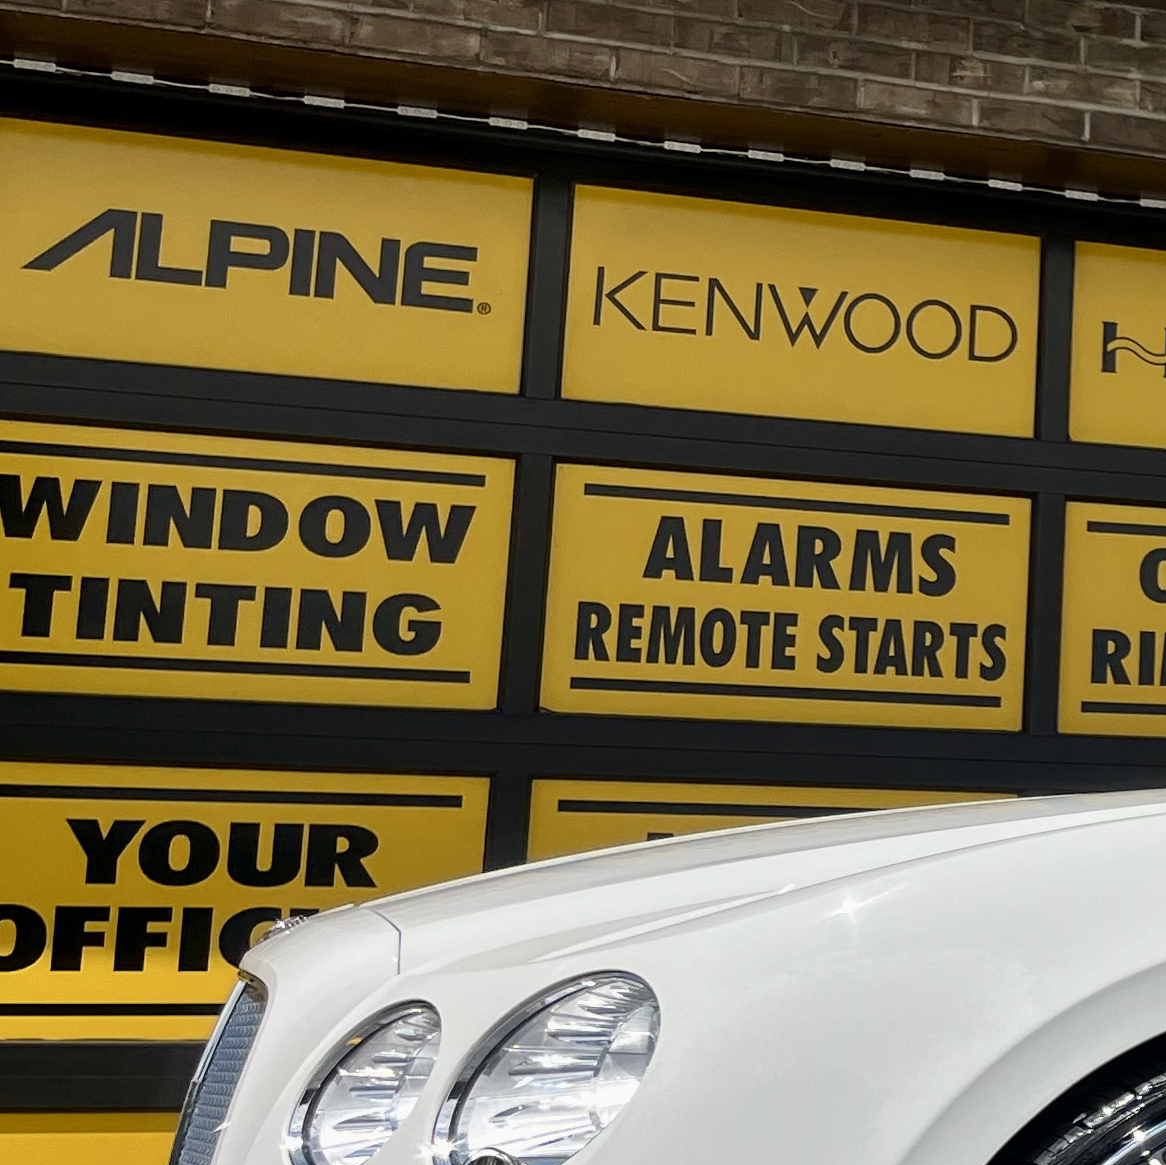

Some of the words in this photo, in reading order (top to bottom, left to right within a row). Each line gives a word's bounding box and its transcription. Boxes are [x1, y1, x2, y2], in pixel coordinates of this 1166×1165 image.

[592, 266, 1018, 363] KENWOOD
[0, 473, 477, 564] WINDOW
[642, 515, 957, 597] ALARMS
[8, 572, 442, 656] TINTING
[573, 600, 799, 671] REMOTE
[816, 614, 1007, 682] STARTS
[66, 818, 379, 889] YOUR
[0, 904, 319, 972] OFFIC
